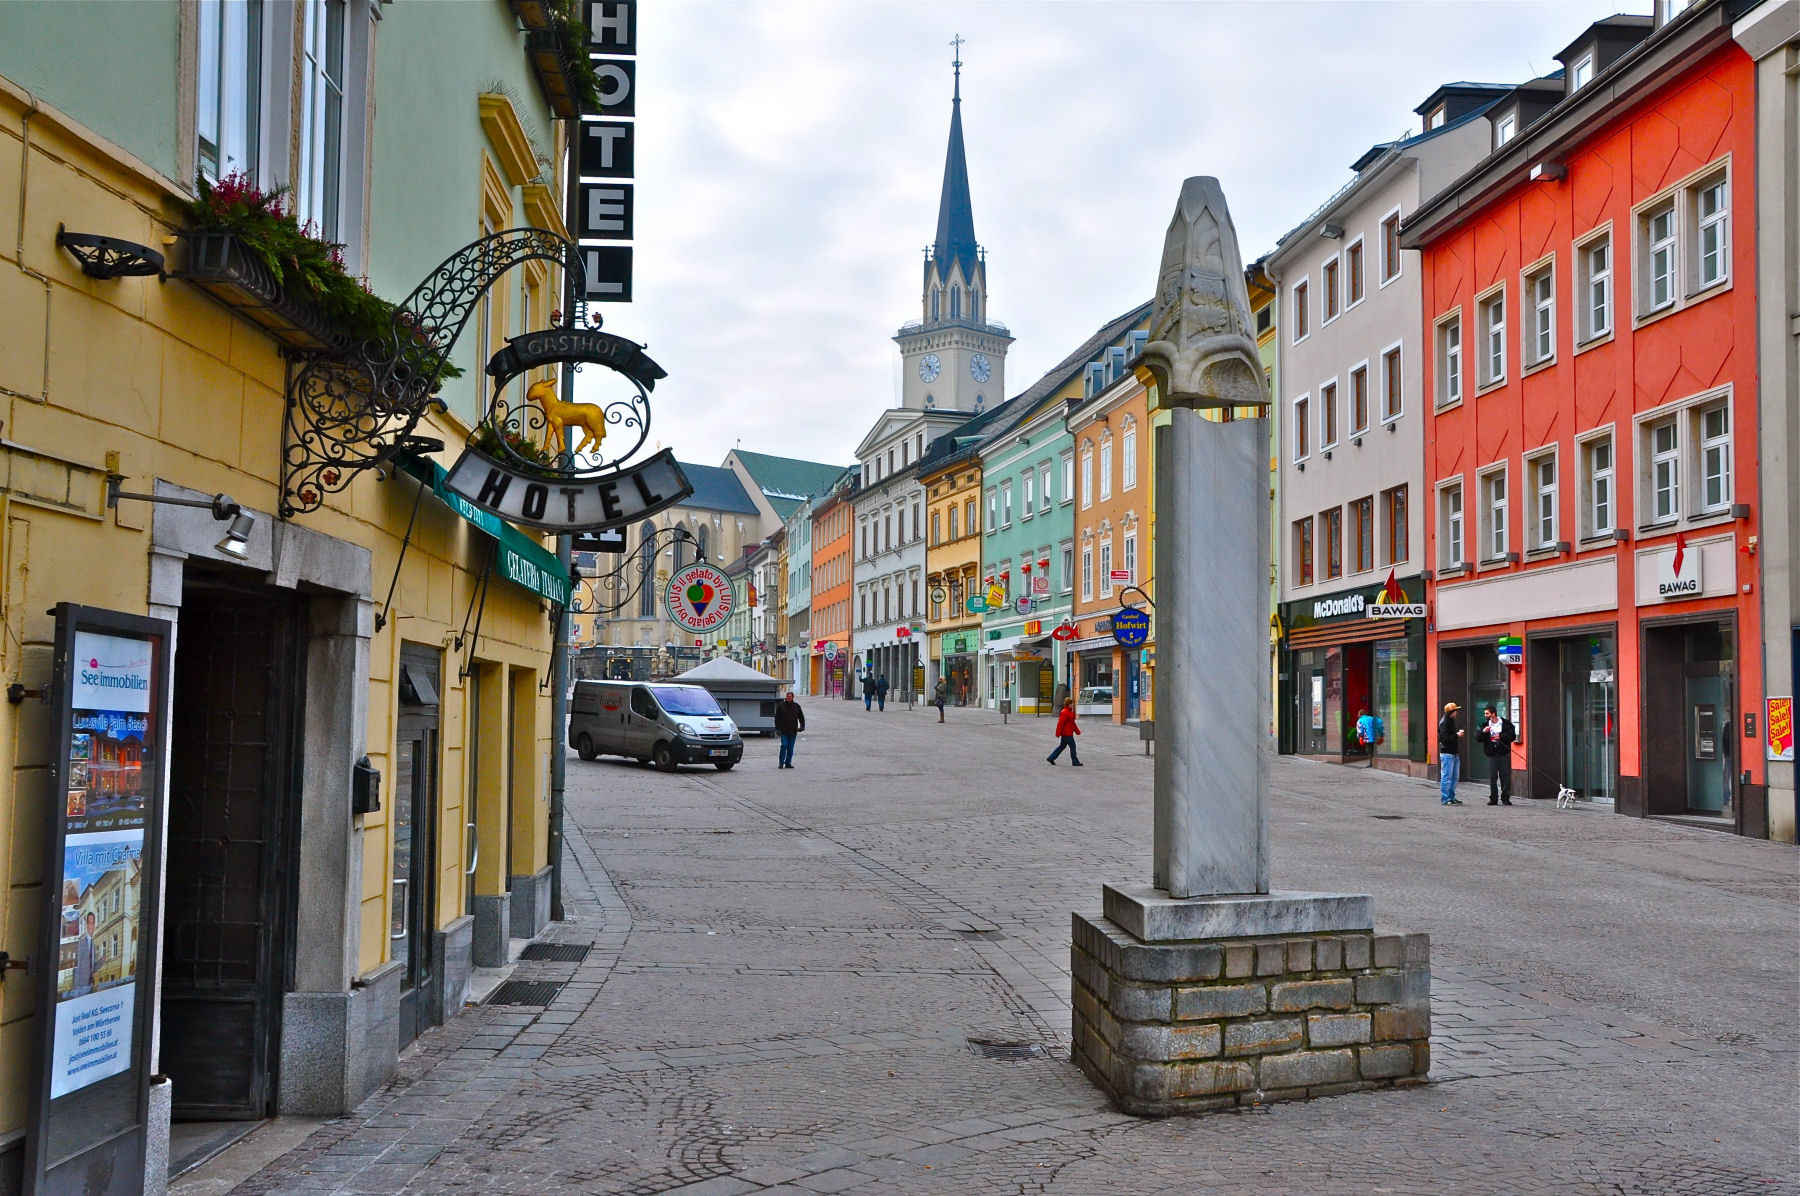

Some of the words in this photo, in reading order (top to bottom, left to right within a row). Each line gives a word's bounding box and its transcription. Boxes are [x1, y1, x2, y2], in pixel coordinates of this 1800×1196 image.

[586, 2, 631, 294] HOTEL
[477, 468, 663, 523] HOTEL
[685, 568, 713, 584] gelato
[713, 574, 725, 588] by
[719, 587, 731, 612] LUIS
[1659, 579, 1697, 595] BAWAG
[670, 584, 682, 610] LUIS
[1313, 593, 1365, 619] McDonald's
[1371, 606, 1424, 616] BAWAG
[676, 608, 688, 622] by
[687, 613, 716, 628] gelato
[1116, 621, 1147, 630] Hofwirt
[1509, 655, 1521, 663] SB
[1770, 708, 1790, 726] Sale!
[75, 848, 93, 865] Villa
[95, 848, 111, 865] mit
